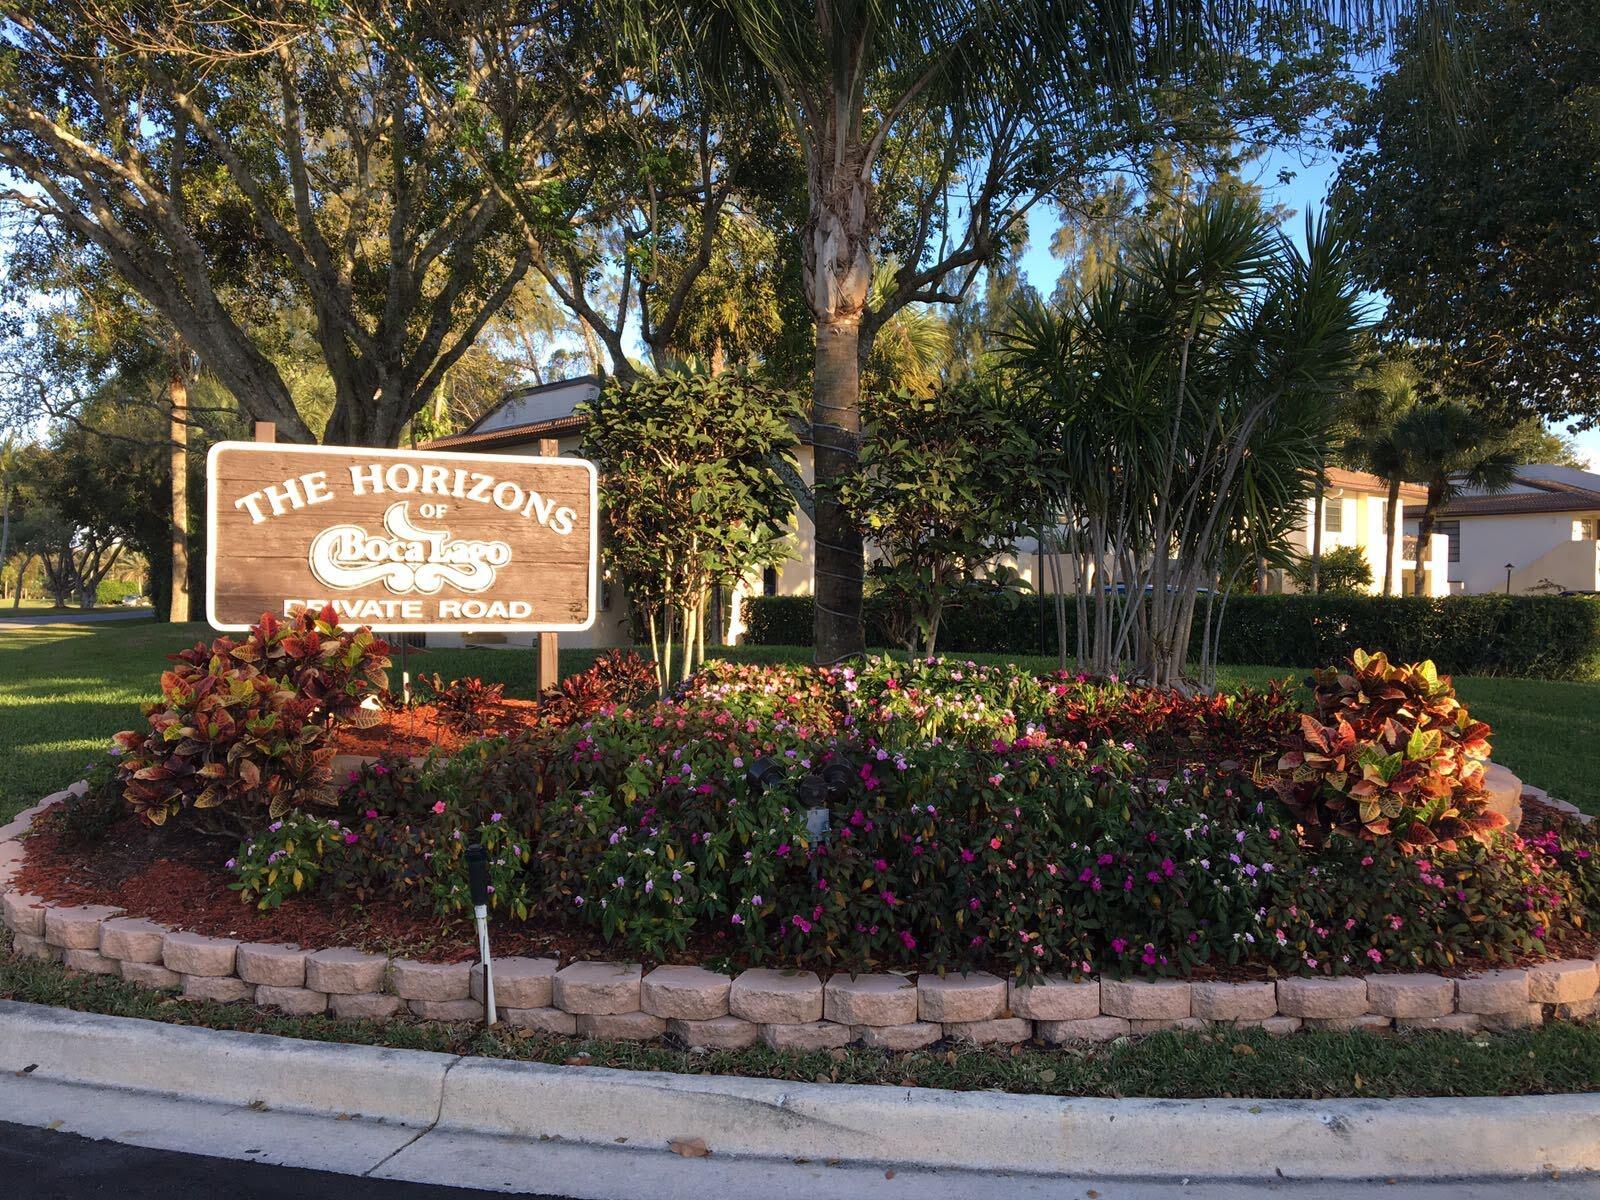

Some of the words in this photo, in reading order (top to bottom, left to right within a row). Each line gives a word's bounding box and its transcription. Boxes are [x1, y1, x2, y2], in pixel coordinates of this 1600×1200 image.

[234, 471, 334, 525] THE
[348, 463, 578, 536] HORIZONS
[419, 503, 448, 519] OF
[322, 527, 425, 568] Boca
[424, 527, 510, 571] Lago
[438, 600, 533, 619] ROAD
